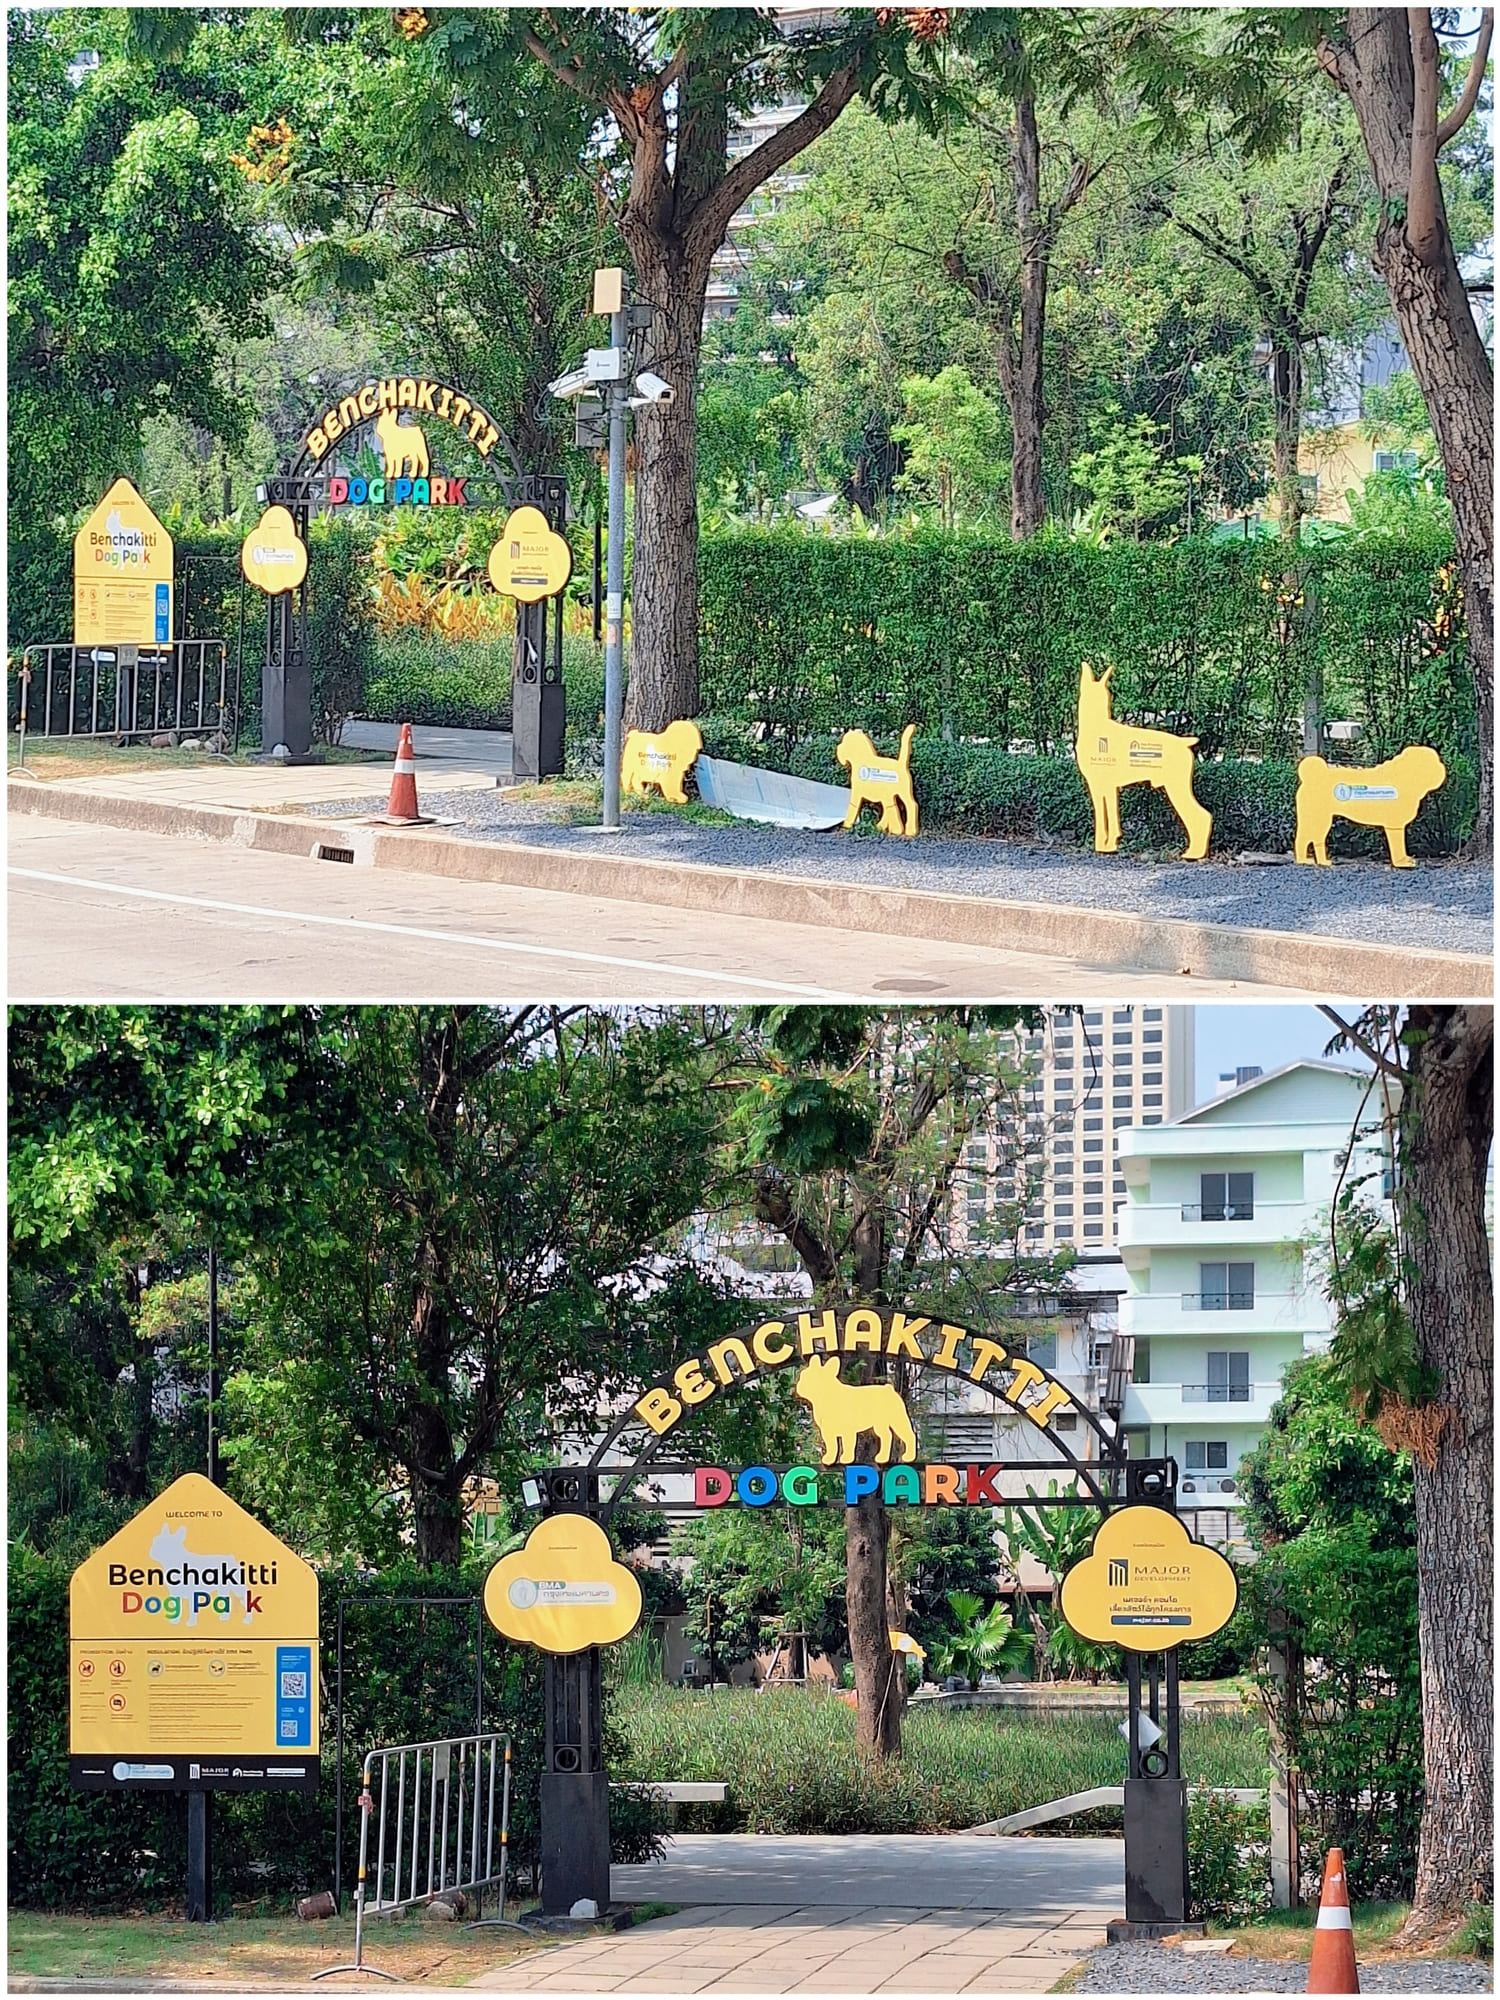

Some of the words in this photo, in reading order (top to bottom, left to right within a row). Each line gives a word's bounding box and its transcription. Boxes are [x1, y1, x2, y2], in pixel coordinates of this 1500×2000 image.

[306, 378, 499, 459] BENCHAKITTI
[329, 478, 386, 505] DOG
[395, 478, 468, 505] PARK
[90, 531, 157, 547] Benchakitti
[95, 548, 119, 566] Dog
[122, 549, 151, 564] Pak
[634, 1309, 1073, 1436] BENCHAKITTI
[694, 1466, 819, 1508] DOG
[845, 1464, 1003, 1507] PARK
[212, 1510, 223, 1518] TO
[109, 1561, 278, 1586] Benchakitti
[1134, 1566, 1191, 1574] MAJOR
[538, 1581, 562, 1589] BMA
[122, 1591, 181, 1619] Dog
[193, 1590, 263, 1614] Pak
